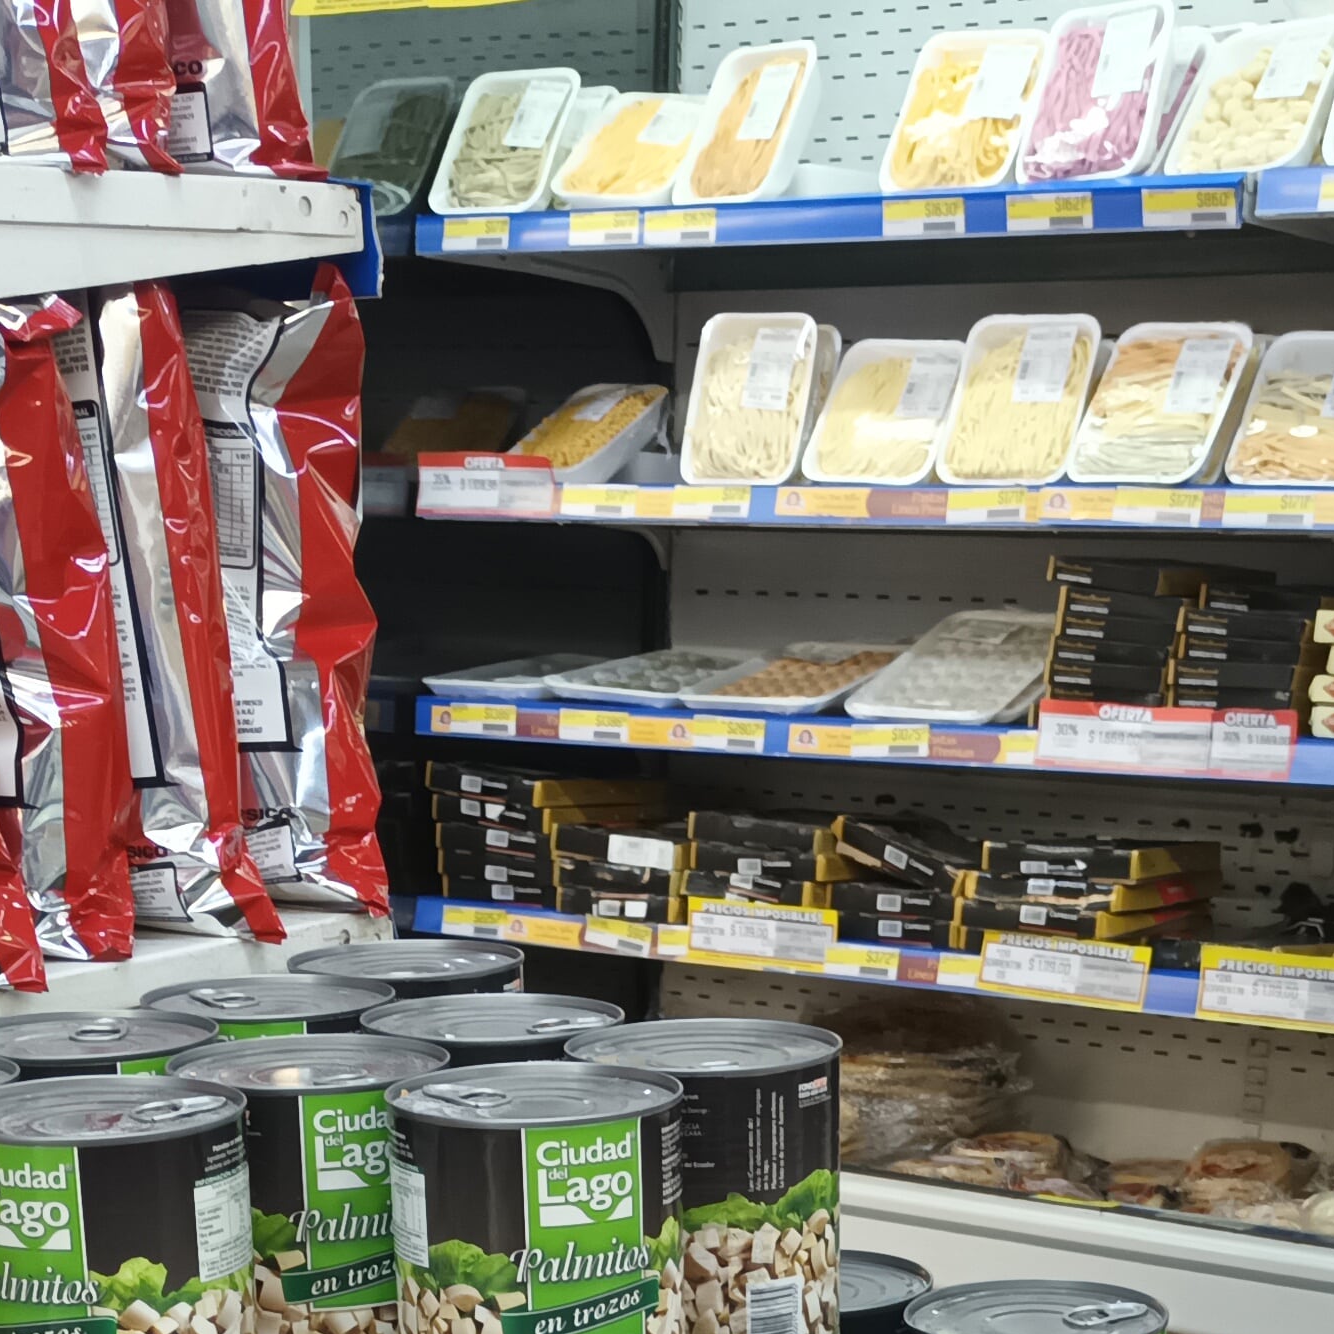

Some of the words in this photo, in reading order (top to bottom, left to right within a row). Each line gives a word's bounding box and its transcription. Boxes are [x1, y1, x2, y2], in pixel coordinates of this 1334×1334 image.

[1099, 705, 1153, 723] OFERTA
[1224, 713, 1277, 727] OFERTA
[702, 903, 747, 916] PRECIOS
[1000, 934, 1051, 949] PRECIOS
[1218, 960, 1275, 974] PRECIOS
[536, 1131, 632, 1166] Ciudad
[550, 1167, 568, 1180] del
[538, 1166, 633, 1211] Lago
[511, 1243, 650, 1283] Palmitos
[573, 1288, 643, 1327] trozos
